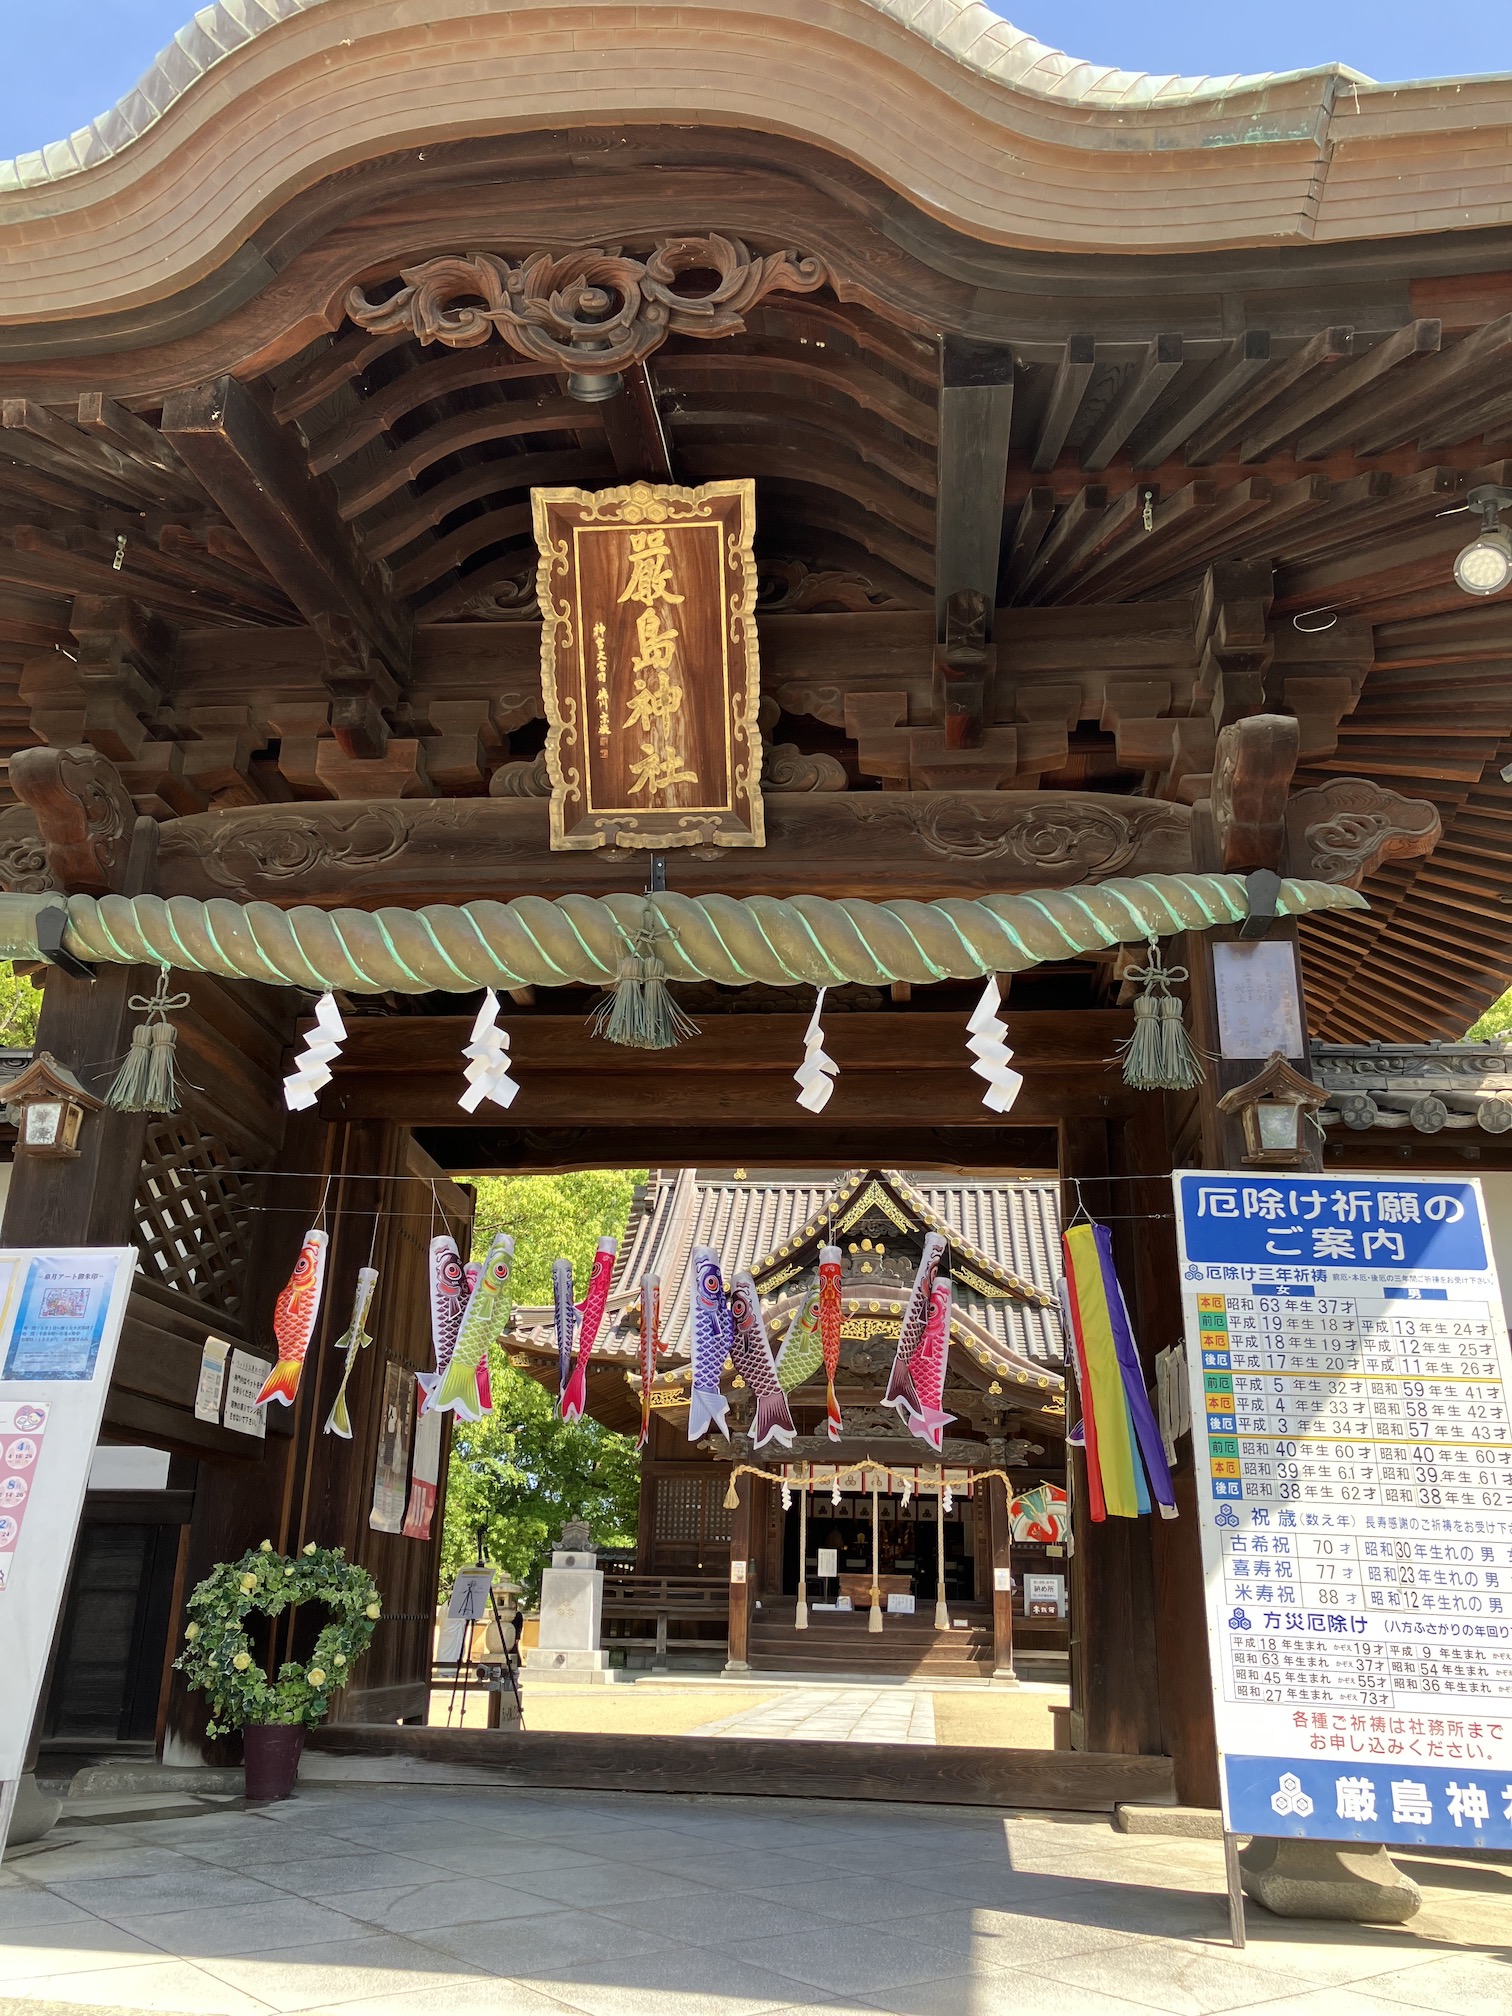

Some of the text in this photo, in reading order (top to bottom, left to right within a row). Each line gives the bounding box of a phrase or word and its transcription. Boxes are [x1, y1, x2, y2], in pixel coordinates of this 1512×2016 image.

[1196, 1187, 1464, 1224] 厄除け祈願の
[1265, 1225, 1405, 1260] ご案内
[1206, 1266, 1328, 1283] 厄除け三年祈祷
[1276, 1284, 1421, 1300] 女 男
[1200, 1297, 1222, 1308] 本厄
[1202, 1315, 1224, 1327] 前厄
[1204, 1335, 1226, 1347] 本厄
[1205, 1353, 1228, 1366] 後厄
[1207, 1377, 1230, 1390] 前厄
[1209, 1397, 1231, 1409] 本厄
[1210, 1418, 1233, 1430] 後厄
[1212, 1441, 1235, 1453] 前厄
[1215, 1461, 1236, 1474] 本厄
[1215, 1482, 1239, 1495] 後厄
[1230, 1534, 1290, 1554] 古希祝
[1313, 1540, 1350, 1554] 70才
[1232, 1559, 1292, 1578] 喜寿祝
[1316, 1564, 1353, 1579] 77才
[1234, 1583, 1295, 1603] 米寿祝
[1319, 1588, 1357, 1604] 88才
[1263, 1611, 1368, 1634] 方災厄除け
[1292, 1710, 1503, 1740] 各種ご祈祷は社務所まで
[1310, 1732, 1492, 1760] お申し込みください。
